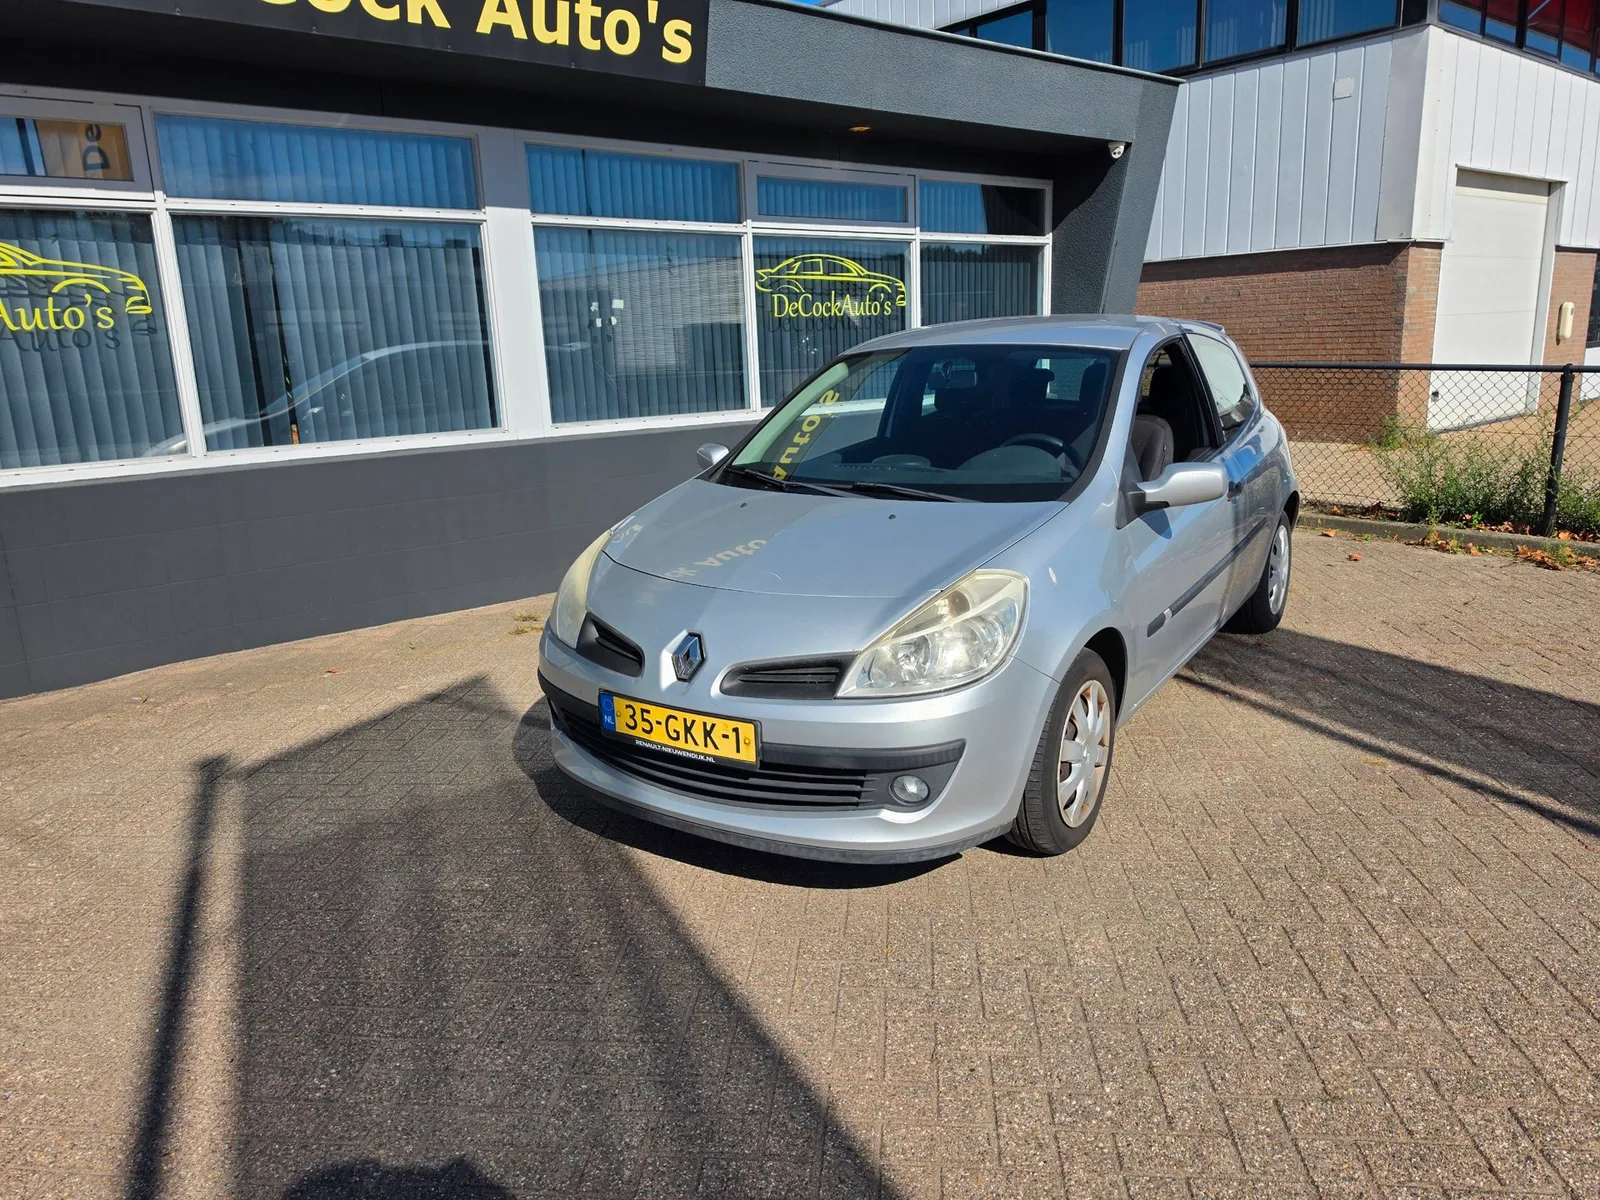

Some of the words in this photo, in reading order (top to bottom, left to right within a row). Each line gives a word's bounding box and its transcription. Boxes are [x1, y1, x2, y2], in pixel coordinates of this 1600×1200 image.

[475, 0, 693, 63] Auto's
[772, 290, 892, 318] DeCockAuto's
[604, 714, 615, 725] NL
[624, 703, 741, 754] 35-GKK-1
[635, 739, 716, 763] RENAULT-NIEUWENDIJK.NL
